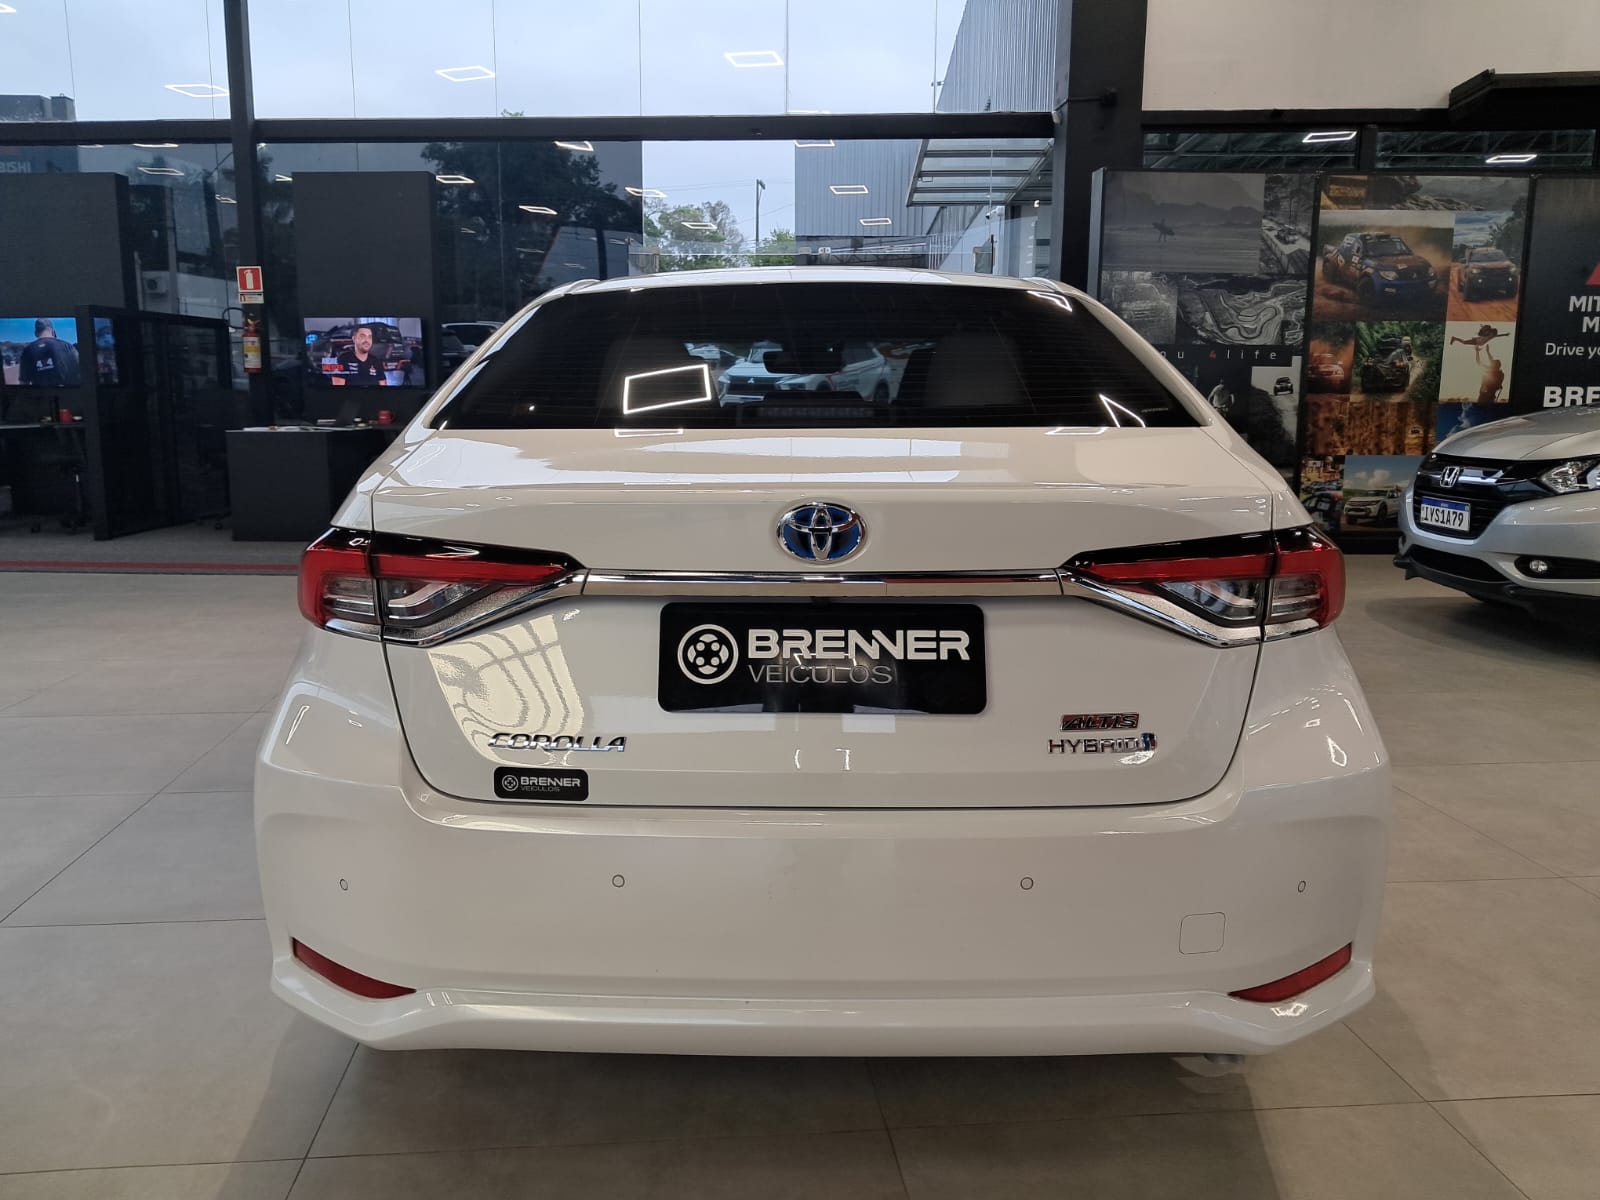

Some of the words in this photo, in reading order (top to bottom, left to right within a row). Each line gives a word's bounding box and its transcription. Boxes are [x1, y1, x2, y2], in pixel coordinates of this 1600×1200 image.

[1545, 342, 1584, 356] Drive
[1424, 506, 1464, 527] IYS1A79
[747, 628, 971, 661] BRENNER
[747, 660, 895, 685] VEÍCULOS
[1061, 713, 1139, 730] ALTIS
[487, 732, 627, 753] COROLLA
[1048, 737, 1141, 753] HYBRID
[520, 776, 581, 788] BRENNER
